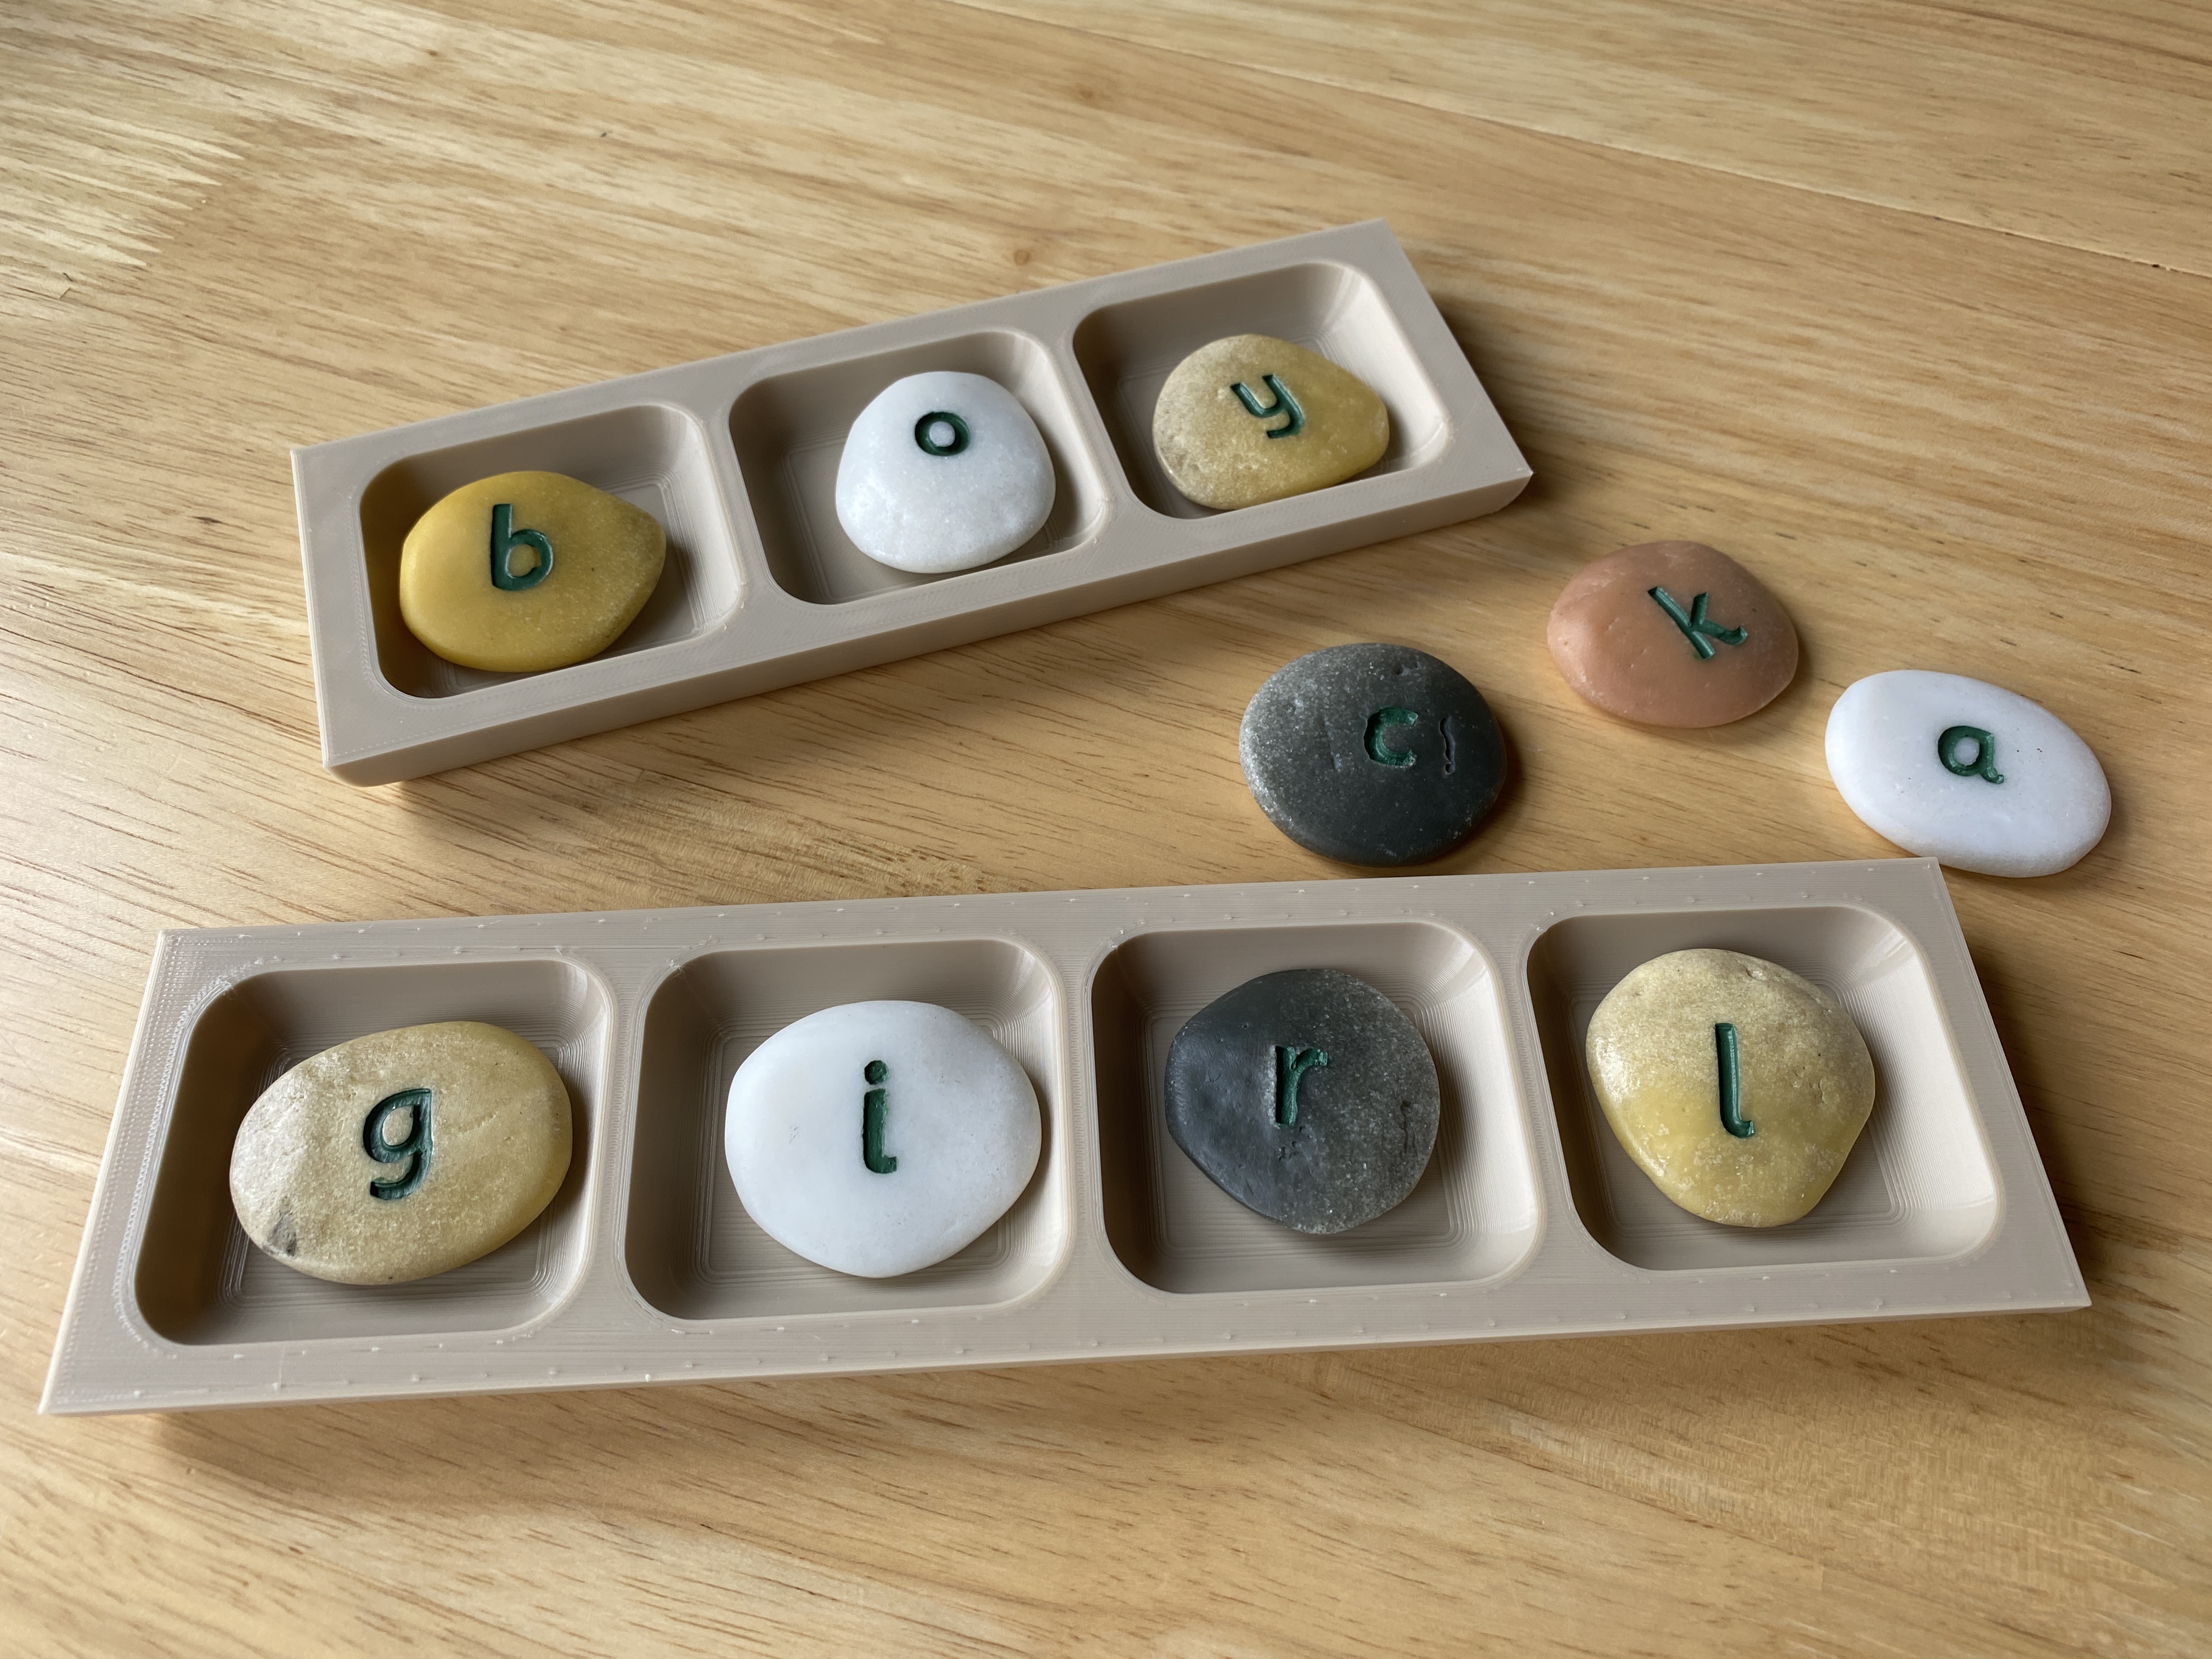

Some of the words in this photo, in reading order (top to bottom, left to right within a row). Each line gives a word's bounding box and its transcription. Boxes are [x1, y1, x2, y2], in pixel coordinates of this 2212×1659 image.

[1648, 587, 1746, 659] k
[1364, 705, 1420, 767] c
[1938, 725, 2004, 784] a
